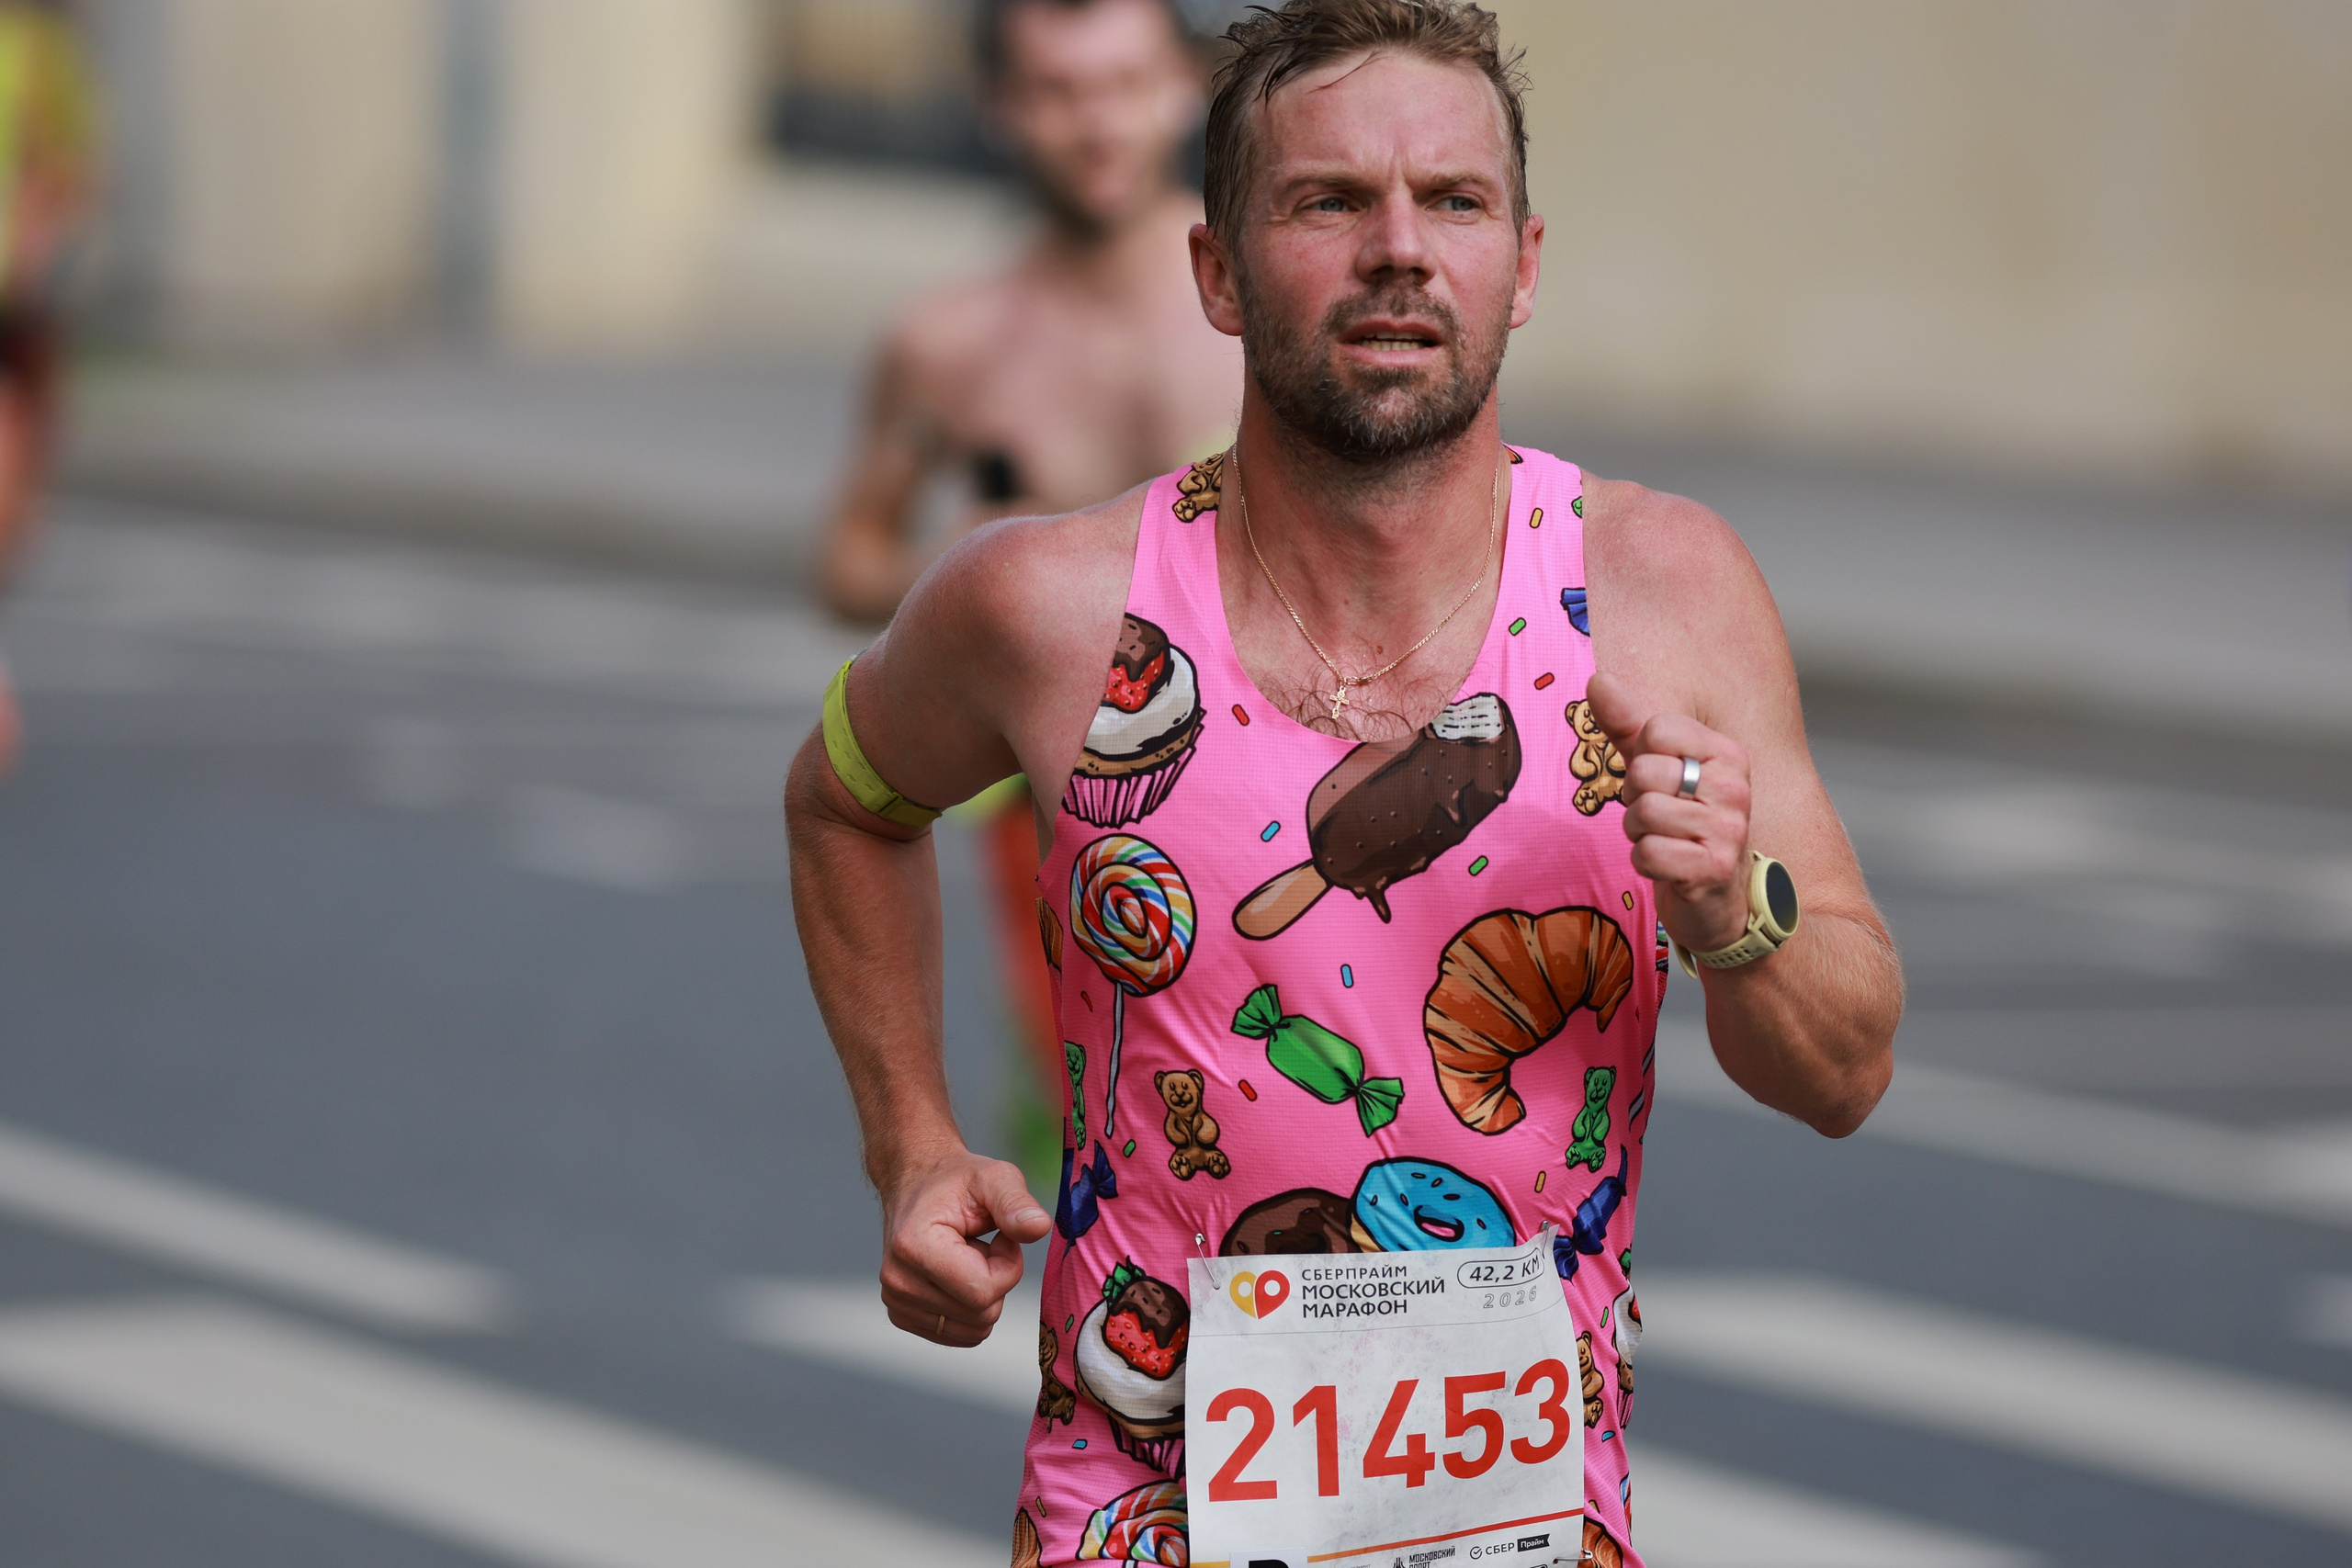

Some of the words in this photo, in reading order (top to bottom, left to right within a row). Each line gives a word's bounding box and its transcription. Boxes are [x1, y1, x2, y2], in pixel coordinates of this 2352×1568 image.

[1302, 1264, 1407, 1280] СБЕРПРАЙМ
[1470, 1265, 1514, 1283] 42,2
[1521, 1255, 1540, 1278] КМ
[1302, 1276, 1445, 1300] МОСКОВСКИЙ
[1483, 1285, 1537, 1309] 2026
[1303, 1299, 1408, 1319] МАРАФОН
[1205, 1358, 1571, 1503] 21453
[1408, 1545, 1456, 1563] МОСКОВСКИЙ
[1485, 1542, 1515, 1555] СБЕР
[1521, 1538, 1544, 1549] Прайм
